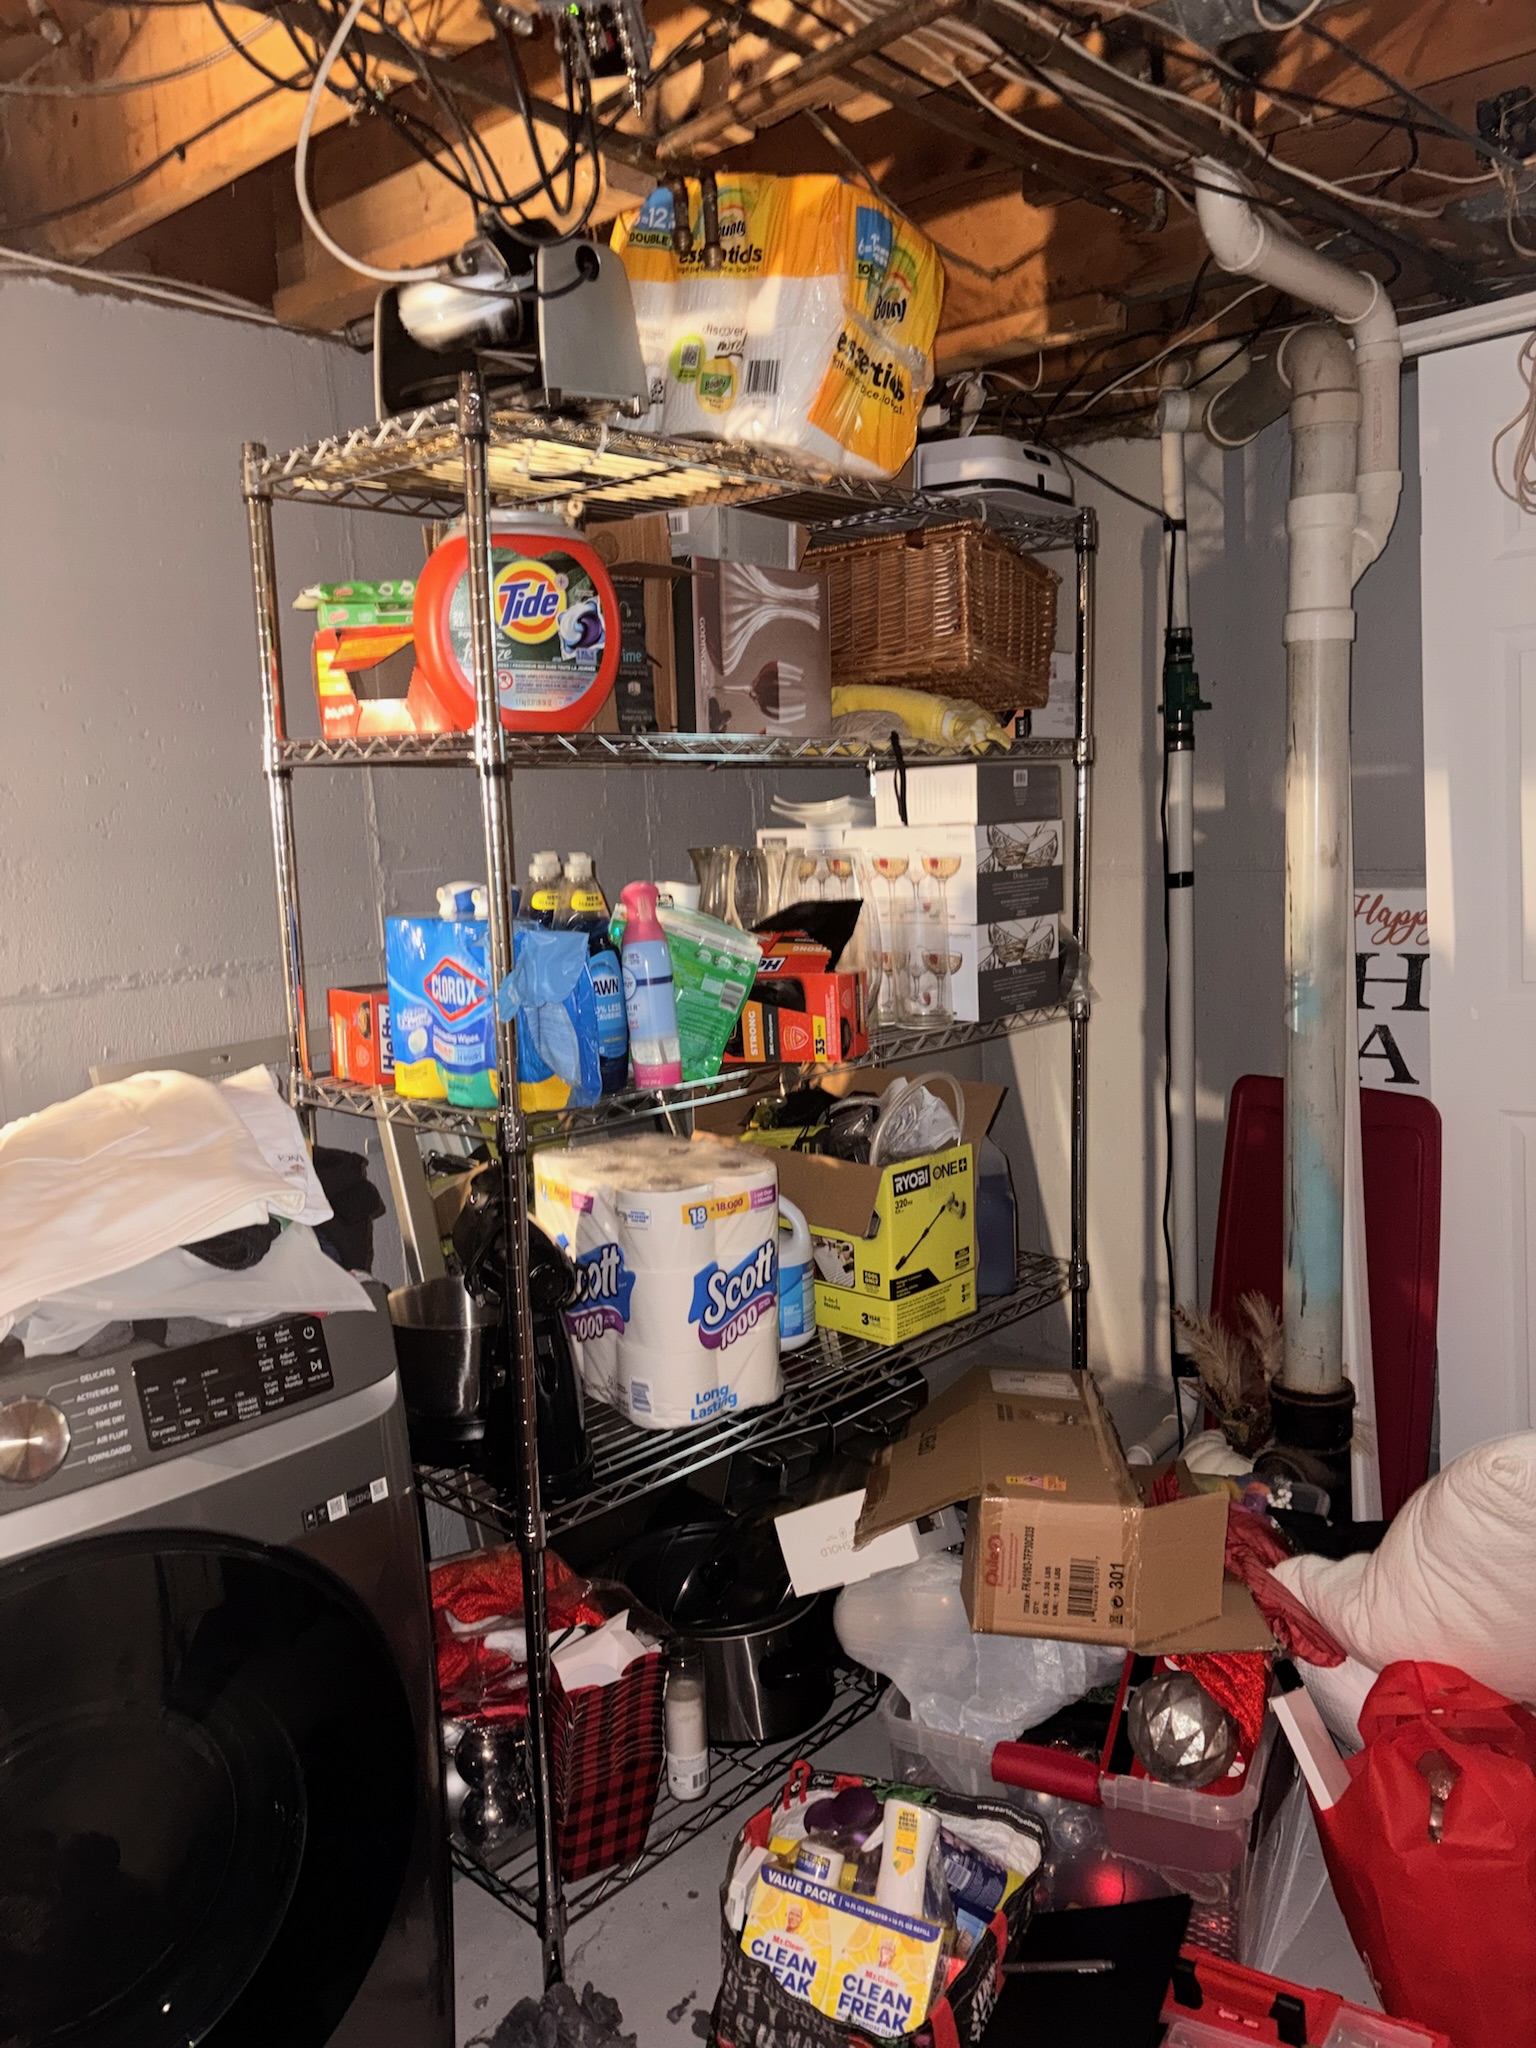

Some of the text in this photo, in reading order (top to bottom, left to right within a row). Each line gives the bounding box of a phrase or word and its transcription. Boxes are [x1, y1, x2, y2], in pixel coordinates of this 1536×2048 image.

[629, 232, 669, 246] DOUBLE
[500, 576, 560, 628] Tide
[431, 973, 477, 1005] CLOROX
[594, 978, 619, 996] AWN
[748, 1010, 759, 1056] STRONG
[815, 1038, 825, 1055] 33
[894, 1169, 929, 1194] RYOBI
[688, 1206, 707, 1226] 18
[577, 1243, 621, 1302] cott
[704, 1239, 774, 1327] Scott
[575, 1312, 604, 1343] 1000
[720, 1305, 758, 1351] 1000
[862, 1312, 869, 1326] 3
[80, 1367, 116, 1383] DELICATES
[284, 1379, 303, 1389] Monitor
[76, 1384, 119, 1403] ACTIVEWEAR
[265, 1386, 279, 1396] Light
[695, 1384, 729, 1406] Long
[87, 1399, 122, 1416] QUICK DRY
[213, 1409, 228, 1419] Time
[690, 1392, 738, 1421] Lasting
[94, 1413, 126, 1429] TIME DRY
[152, 1425, 177, 1438] Dryness
[96, 1428, 128, 1446] AIR FLUFF
[87, 1443, 132, 1464] DOWNLOADED
[1108, 1563, 1125, 1589] 301
[768, 1869, 802, 1892] VALUE
[803, 1882, 837, 1905] PACK
[864, 1906, 888, 1921] SPRAYER
[912, 1924, 931, 1937] REFILL
[751, 1939, 817, 1977] CLEAN
[771, 1966, 813, 1997] EAK
[842, 1974, 913, 2014] CLEAN
[837, 1992, 909, 2035] FREAK
